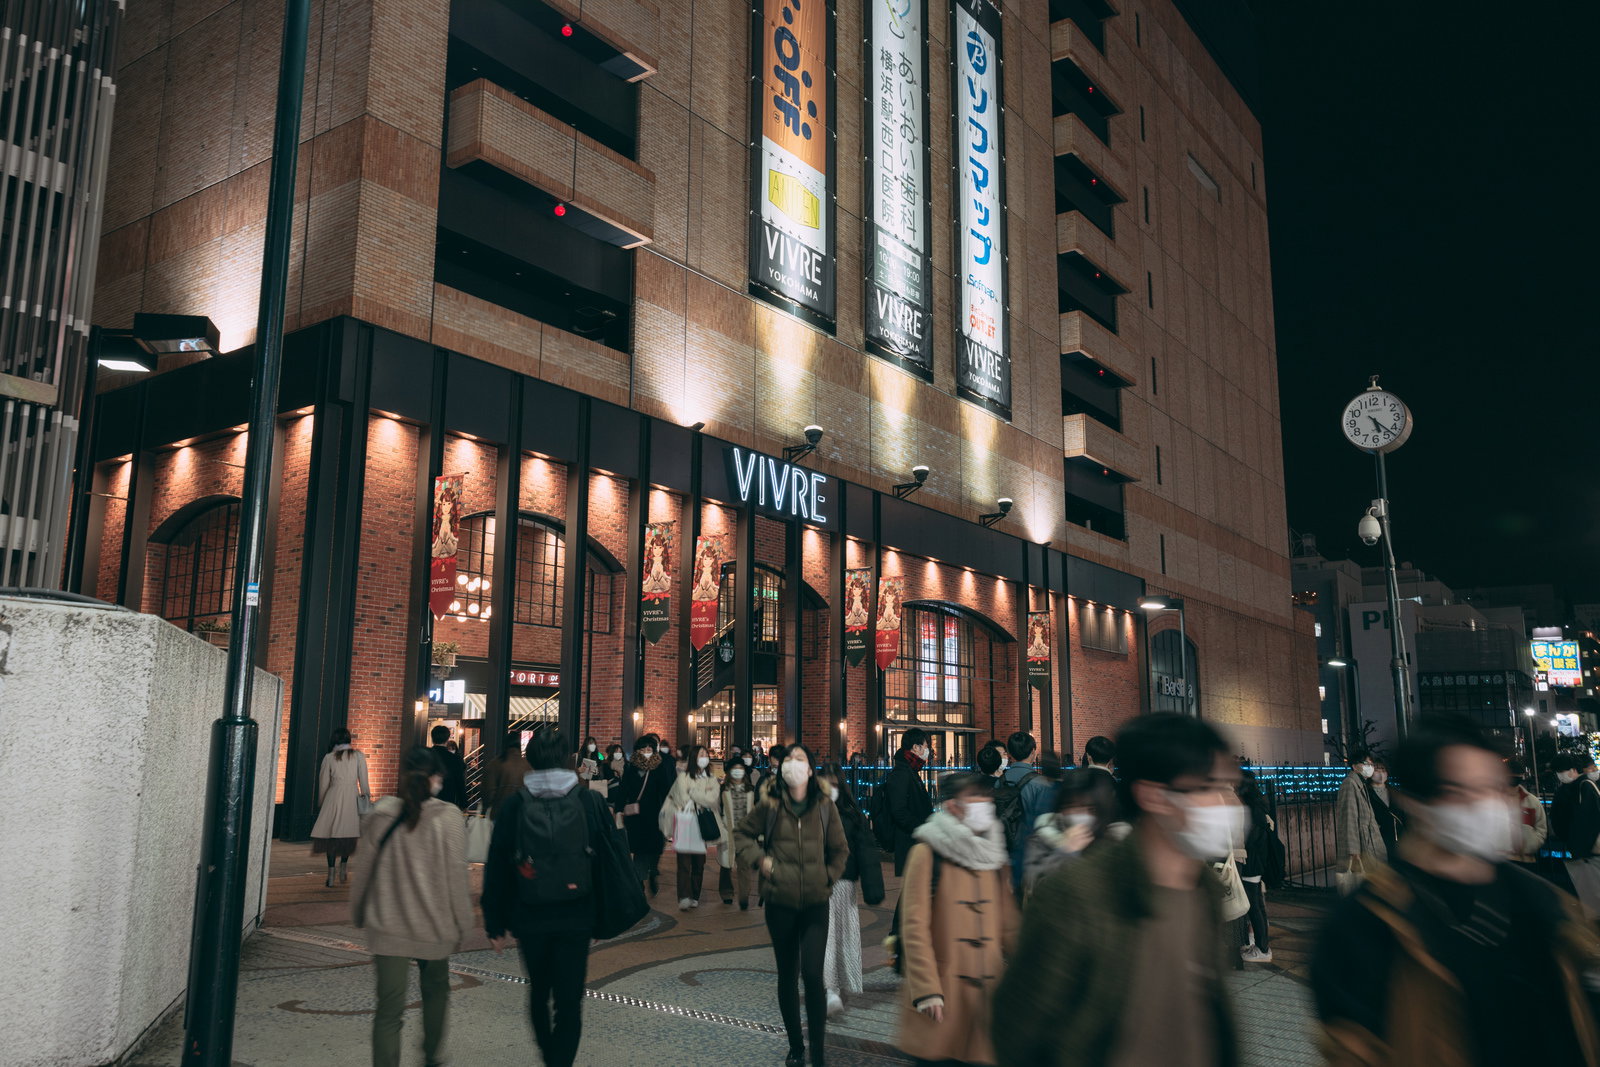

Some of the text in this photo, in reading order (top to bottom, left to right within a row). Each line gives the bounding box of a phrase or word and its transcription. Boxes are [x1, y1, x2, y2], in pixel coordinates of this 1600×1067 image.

[880, 46, 894, 226] 横浜駅西口医院
[967, 74, 992, 265] ソフマップ
[764, 225, 822, 286] VIVRE
[768, 267, 819, 301] YOKOHAMA
[876, 288, 923, 339] VIVRE
[965, 339, 1002, 381] VIVRE
[968, 371, 1000, 393] YOKOHAMA
[1369, 397, 1379, 406] 12
[1389, 403, 1396, 412] 2
[1350, 409, 1361, 418] 10
[1393, 412, 1400, 421] 3
[1349, 419, 1356, 428] 9
[1390, 422, 1398, 431] 4
[1353, 427, 1361, 436] 8
[1362, 434, 1369, 442] 7
[1372, 434, 1380, 443] 6
[733, 447, 827, 523] VIVRE
